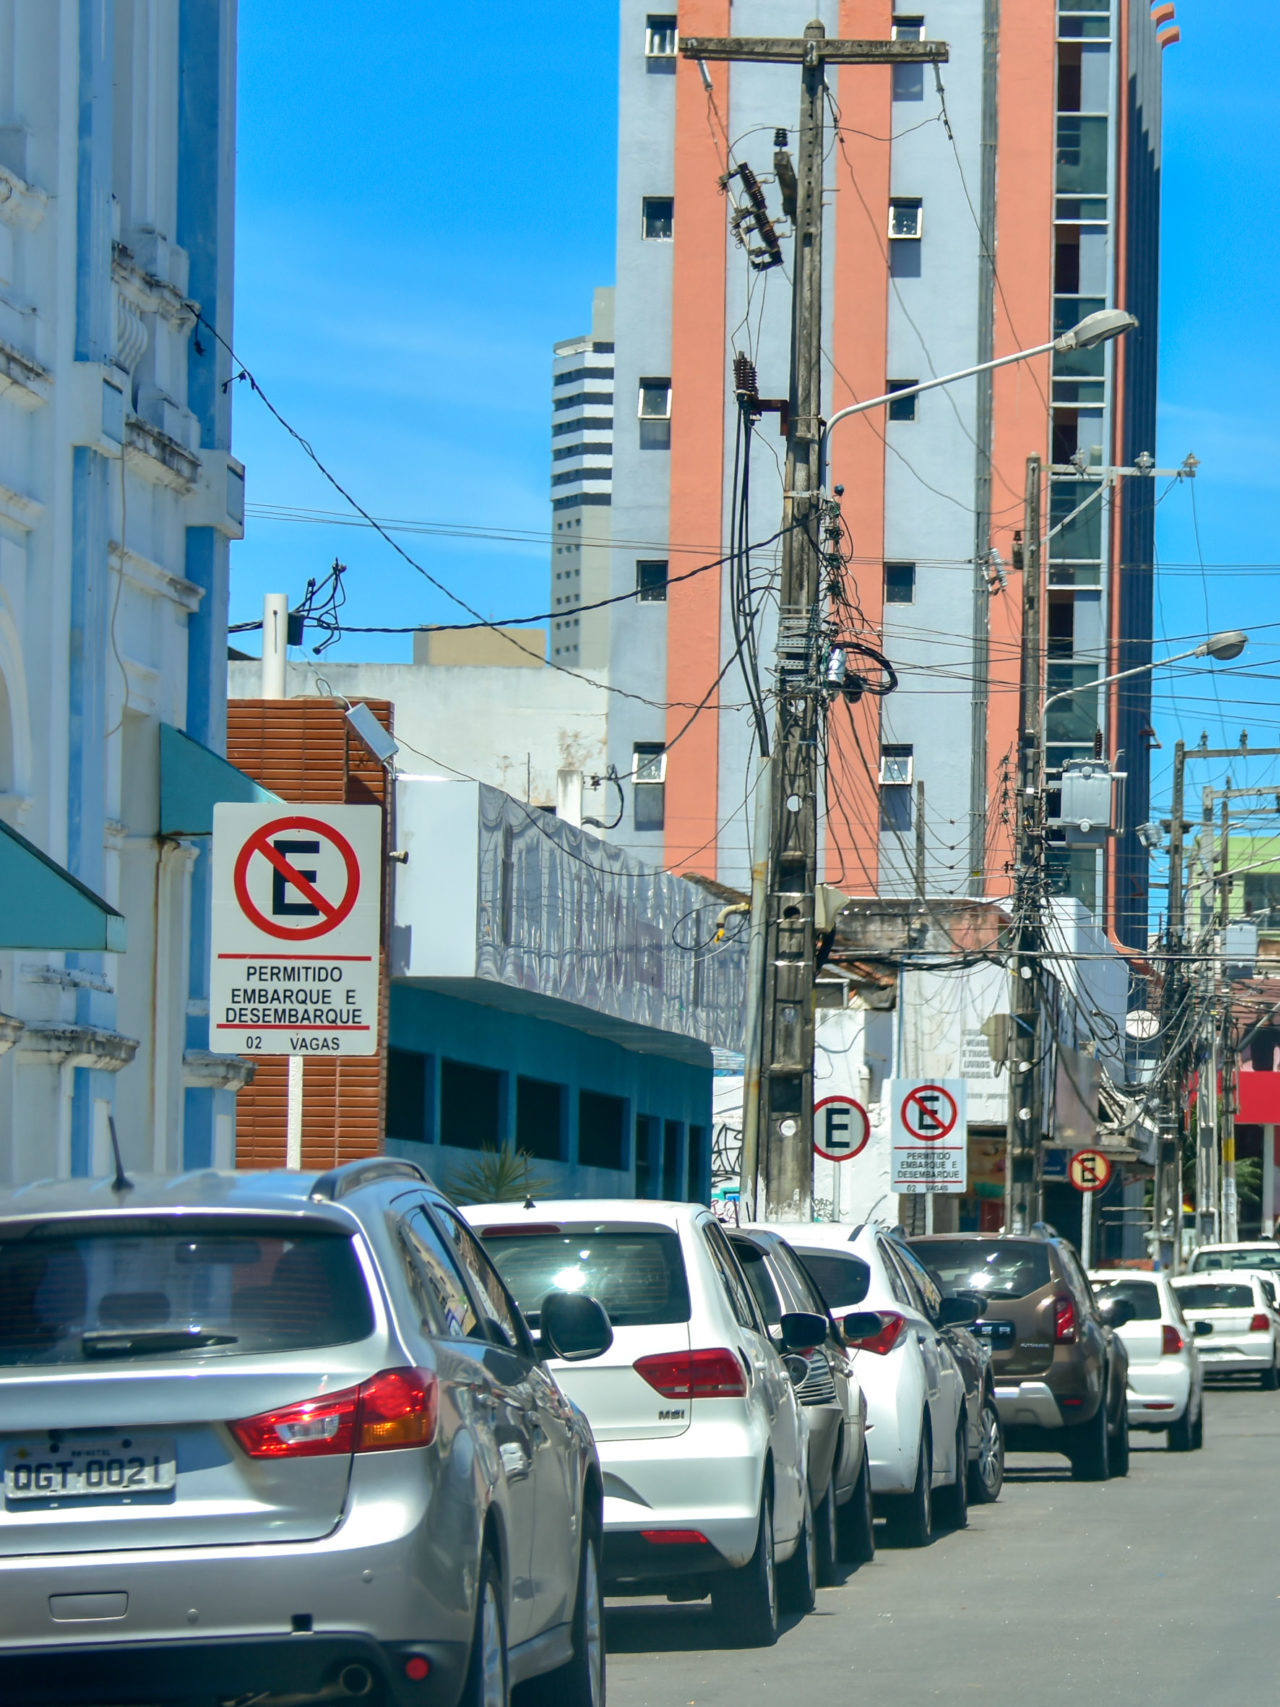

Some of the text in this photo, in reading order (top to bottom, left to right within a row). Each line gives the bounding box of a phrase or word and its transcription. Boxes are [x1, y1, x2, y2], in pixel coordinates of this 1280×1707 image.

[272, 840, 320, 916] E
[247, 966, 343, 982] PERMITIDO
[231, 988, 356, 1006] EMBARQUE E
[226, 1007, 362, 1026] DESEMBARQUE
[246, 1036, 340, 1051] 02 VAGAS
[918, 1096, 940, 1130] E
[826, 1108, 850, 1148] E
[907, 1152, 950, 1160] PERMITIDO
[901, 1161, 946, 1169] EMBARQUE
[898, 1170, 960, 1179] DESEMBARQUE
